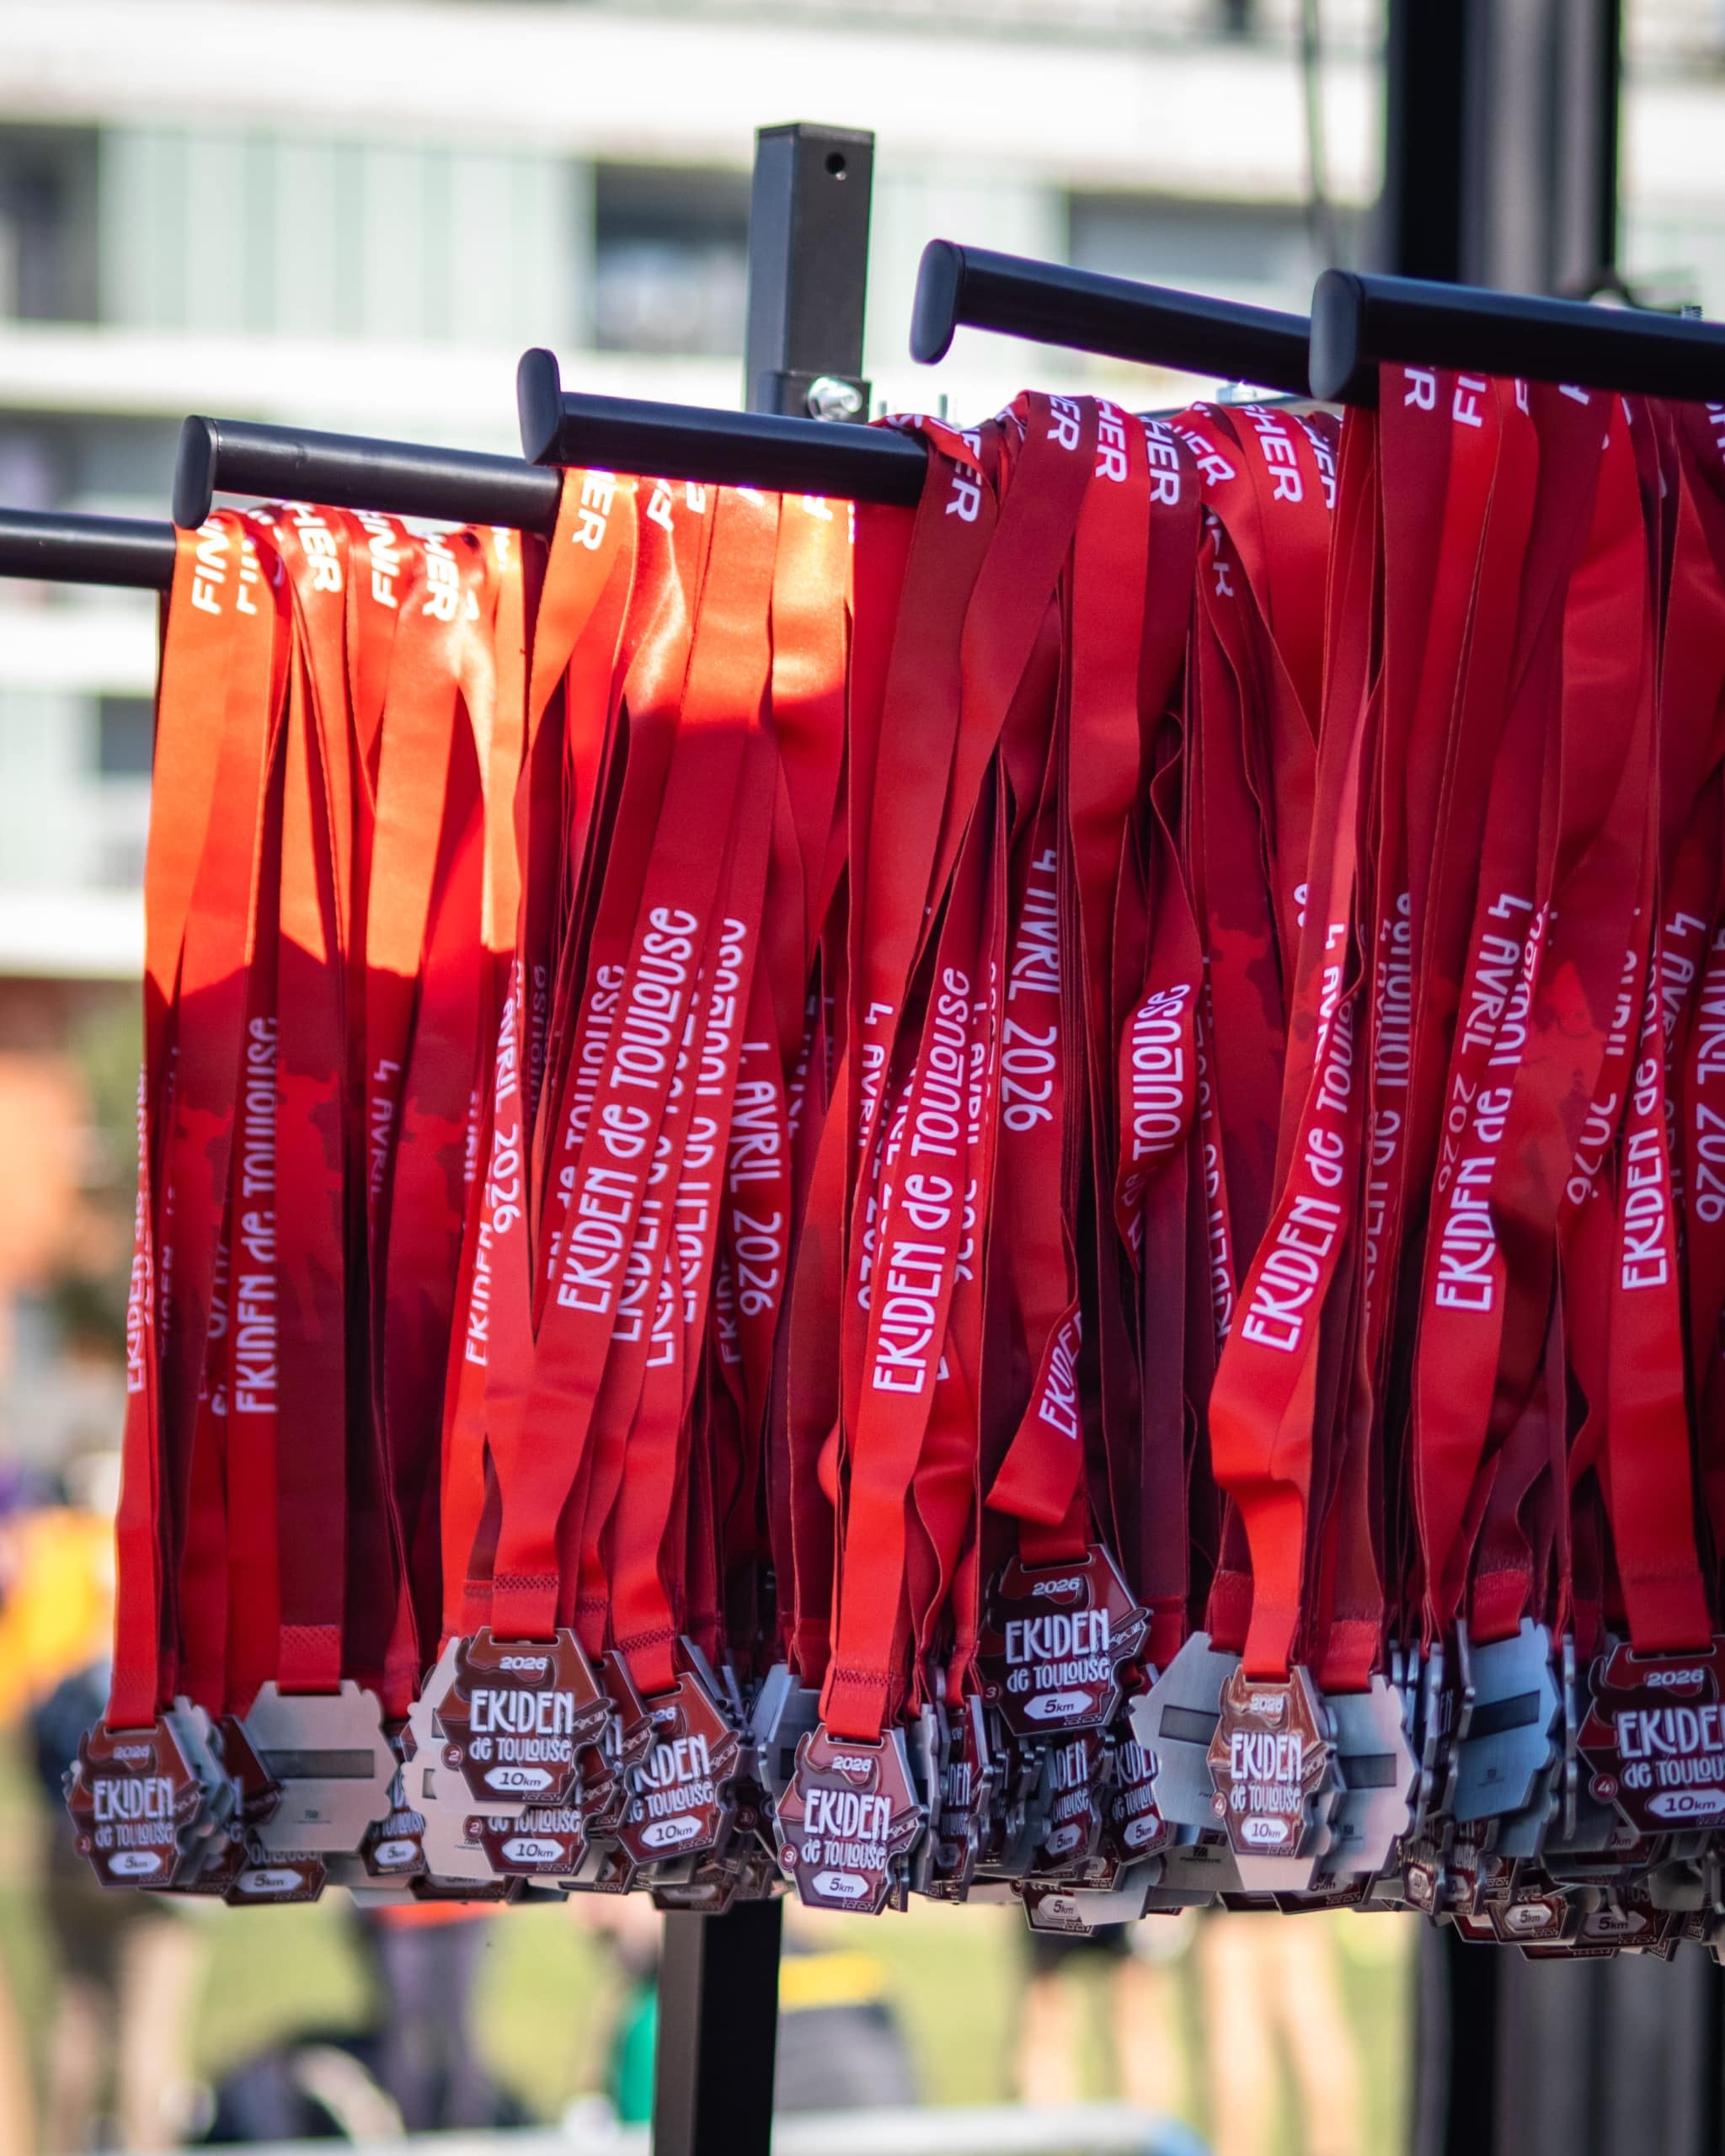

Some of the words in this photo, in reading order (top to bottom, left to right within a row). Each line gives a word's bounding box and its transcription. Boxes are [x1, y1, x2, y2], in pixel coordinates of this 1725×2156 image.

[1487, 893, 1533, 919] 4
[1666, 912, 1706, 937] 4
[1461, 934, 1520, 1054] AVRIL
[1001, 1019, 1058, 1131] 2026
[1632, 1059, 1658, 1117] de
[729, 1081, 781, 1193] AVRIL
[489, 1123, 521, 1235] 2026
[557, 1166, 638, 1312] EKIDEN
[598, 1106, 651, 1159] de
[901, 1175, 952, 1230] de
[1435, 1156, 1496, 1312] EKIDEN
[1472, 1087, 1513, 1143] de
[1622, 1129, 1667, 1290] EKIDEN
[240, 1213, 277, 1263] de
[1242, 1196, 1341, 1353] EKIDEN
[1305, 1128, 1343, 1188] de
[732, 1209, 782, 1315] 2026
[873, 1242, 944, 1393] EKIDEN
[236, 1275, 278, 1413] EKIDEN
[1033, 1577, 1080, 1596] 2026
[1006, 1609, 1110, 1664] EKIDEN
[499, 1657, 547, 1670] 2026
[1007, 1668, 1029, 1693] de
[1647, 1668, 1705, 1687] 2026
[470, 1689, 574, 1734] EKIDEN
[1044, 1699, 1074, 1714] 5km
[1251, 1695, 1284, 1712] 2026
[1617, 1704, 1725, 1758] EKIDE
[469, 1737, 492, 1760] de
[1231, 1732, 1302, 1782] EKIDEN
[831, 1755, 873, 1772] 2026
[1624, 1762, 1653, 1789] de
[499, 1771, 542, 1786] 10km
[93, 1778, 174, 1821] EKIDEN
[1231, 1784, 1247, 1811] de
[1664, 1796, 1717, 1813] 10km
[804, 1788, 892, 1841] EKIDEN
[95, 1824, 113, 1848] de
[655, 1824, 693, 1843] 10km
[1056, 1833, 1073, 1848] 5km
[1135, 1823, 1152, 1838] 5km
[1252, 1823, 1281, 1838] 10km
[124, 1855, 148, 1868] 5km
[515, 1844, 554, 1858] 10km
[801, 1838, 822, 1864] de
[254, 1874, 285, 1887] 5km
[829, 1877, 854, 1894] 5km
[1052, 1900, 1074, 1915] 5km
[1519, 1909, 1541, 1924] 5km
[1598, 1916, 1629, 1931] 5km
